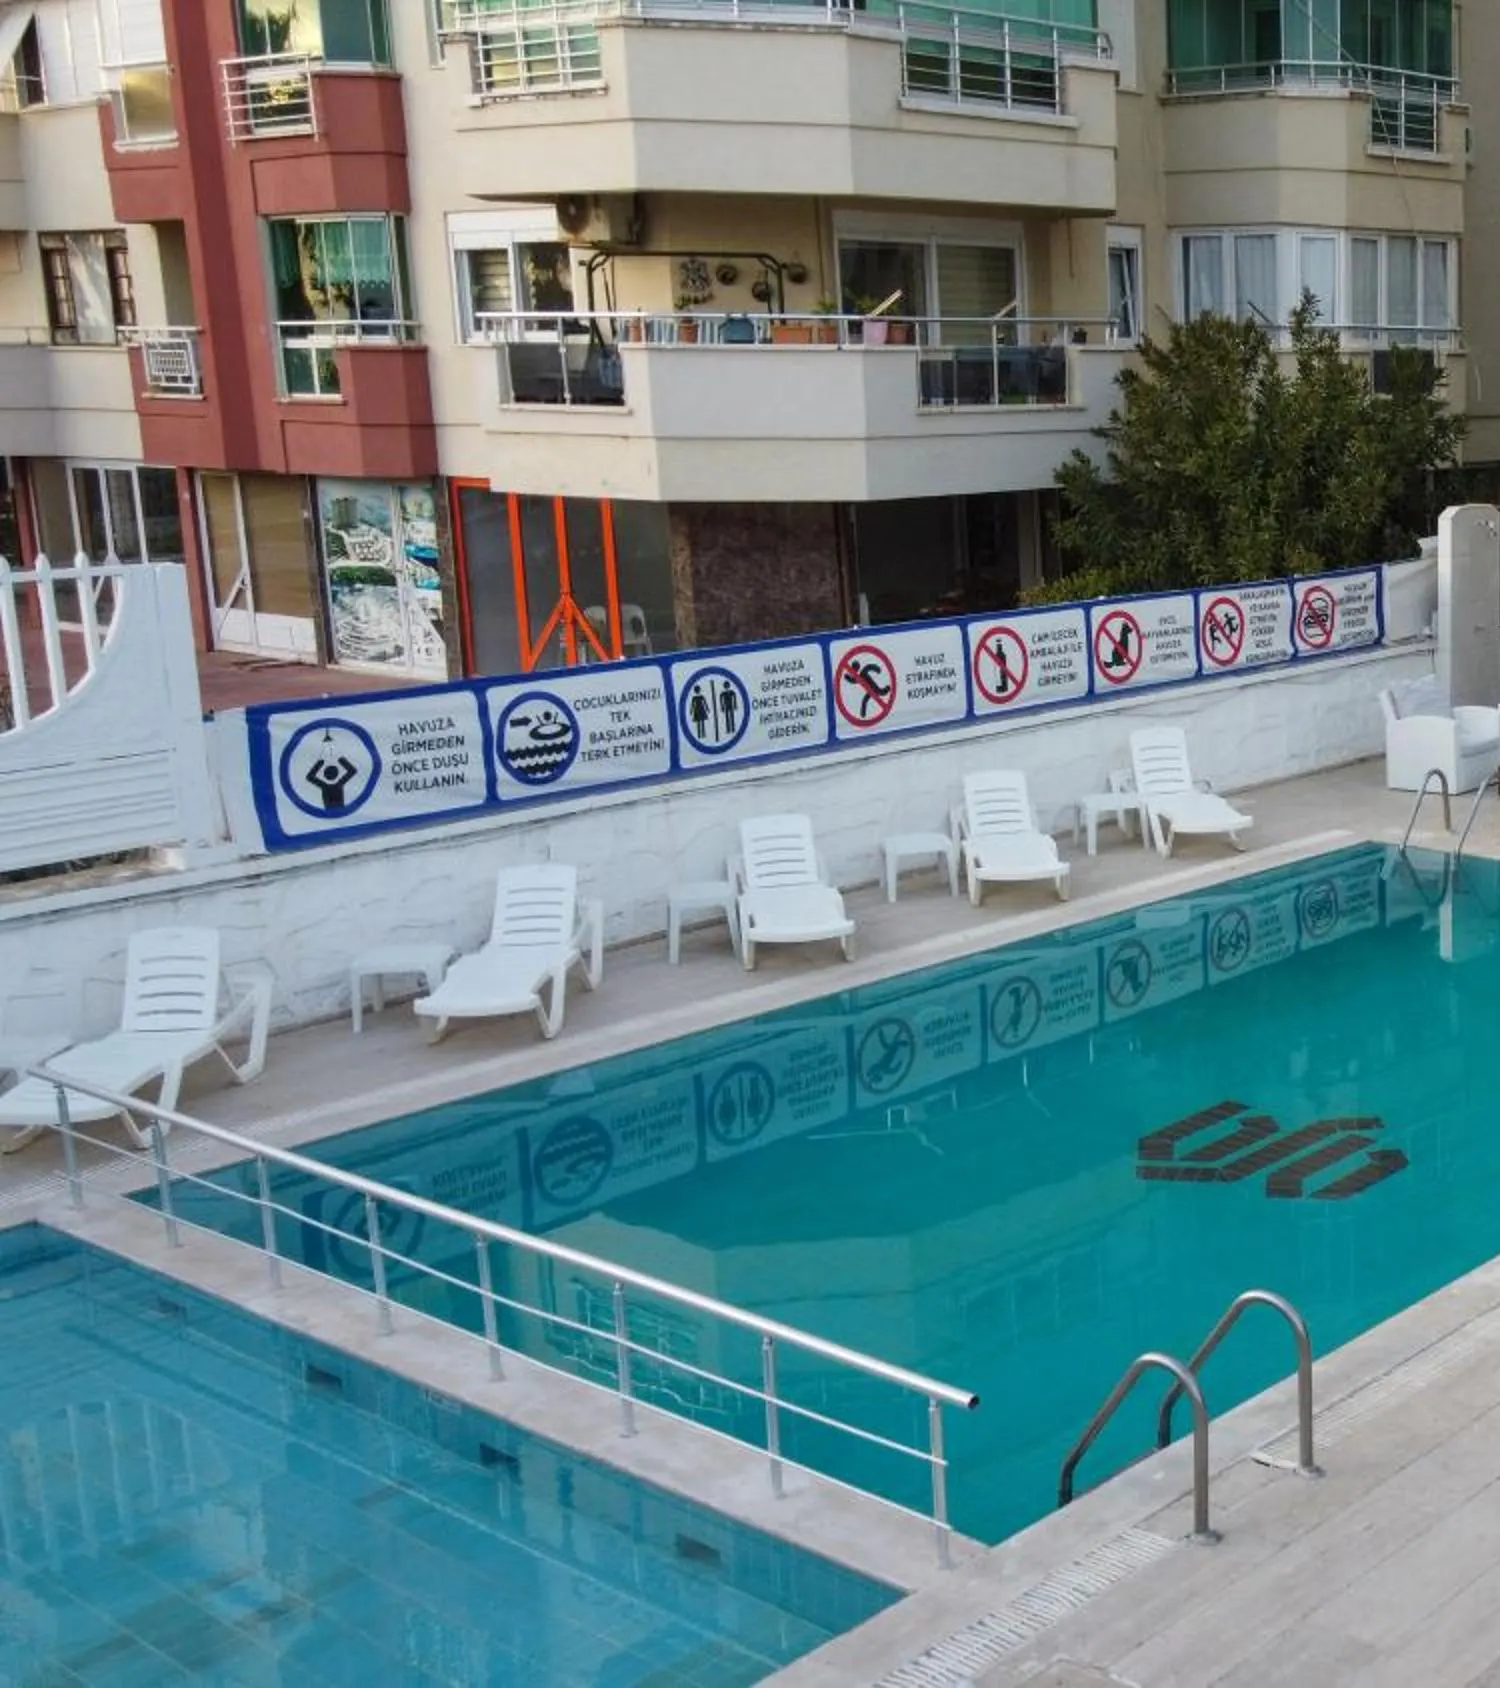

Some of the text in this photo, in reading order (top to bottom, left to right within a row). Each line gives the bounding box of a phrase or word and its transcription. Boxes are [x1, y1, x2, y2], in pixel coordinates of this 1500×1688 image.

[763, 659, 805, 674] HAVUZA
[905, 668, 957, 684] ETRAFINDA
[780, 688, 822, 705] TUVALET
[609, 710, 632, 723] TEK
[398, 717, 456, 736] HAVUZA
[589, 723, 654, 745] BAŞLARINA
[391, 735, 465, 756] GİRMEDEN
[581, 748, 611, 762] TERK
[391, 758, 430, 776] ÖNCE
